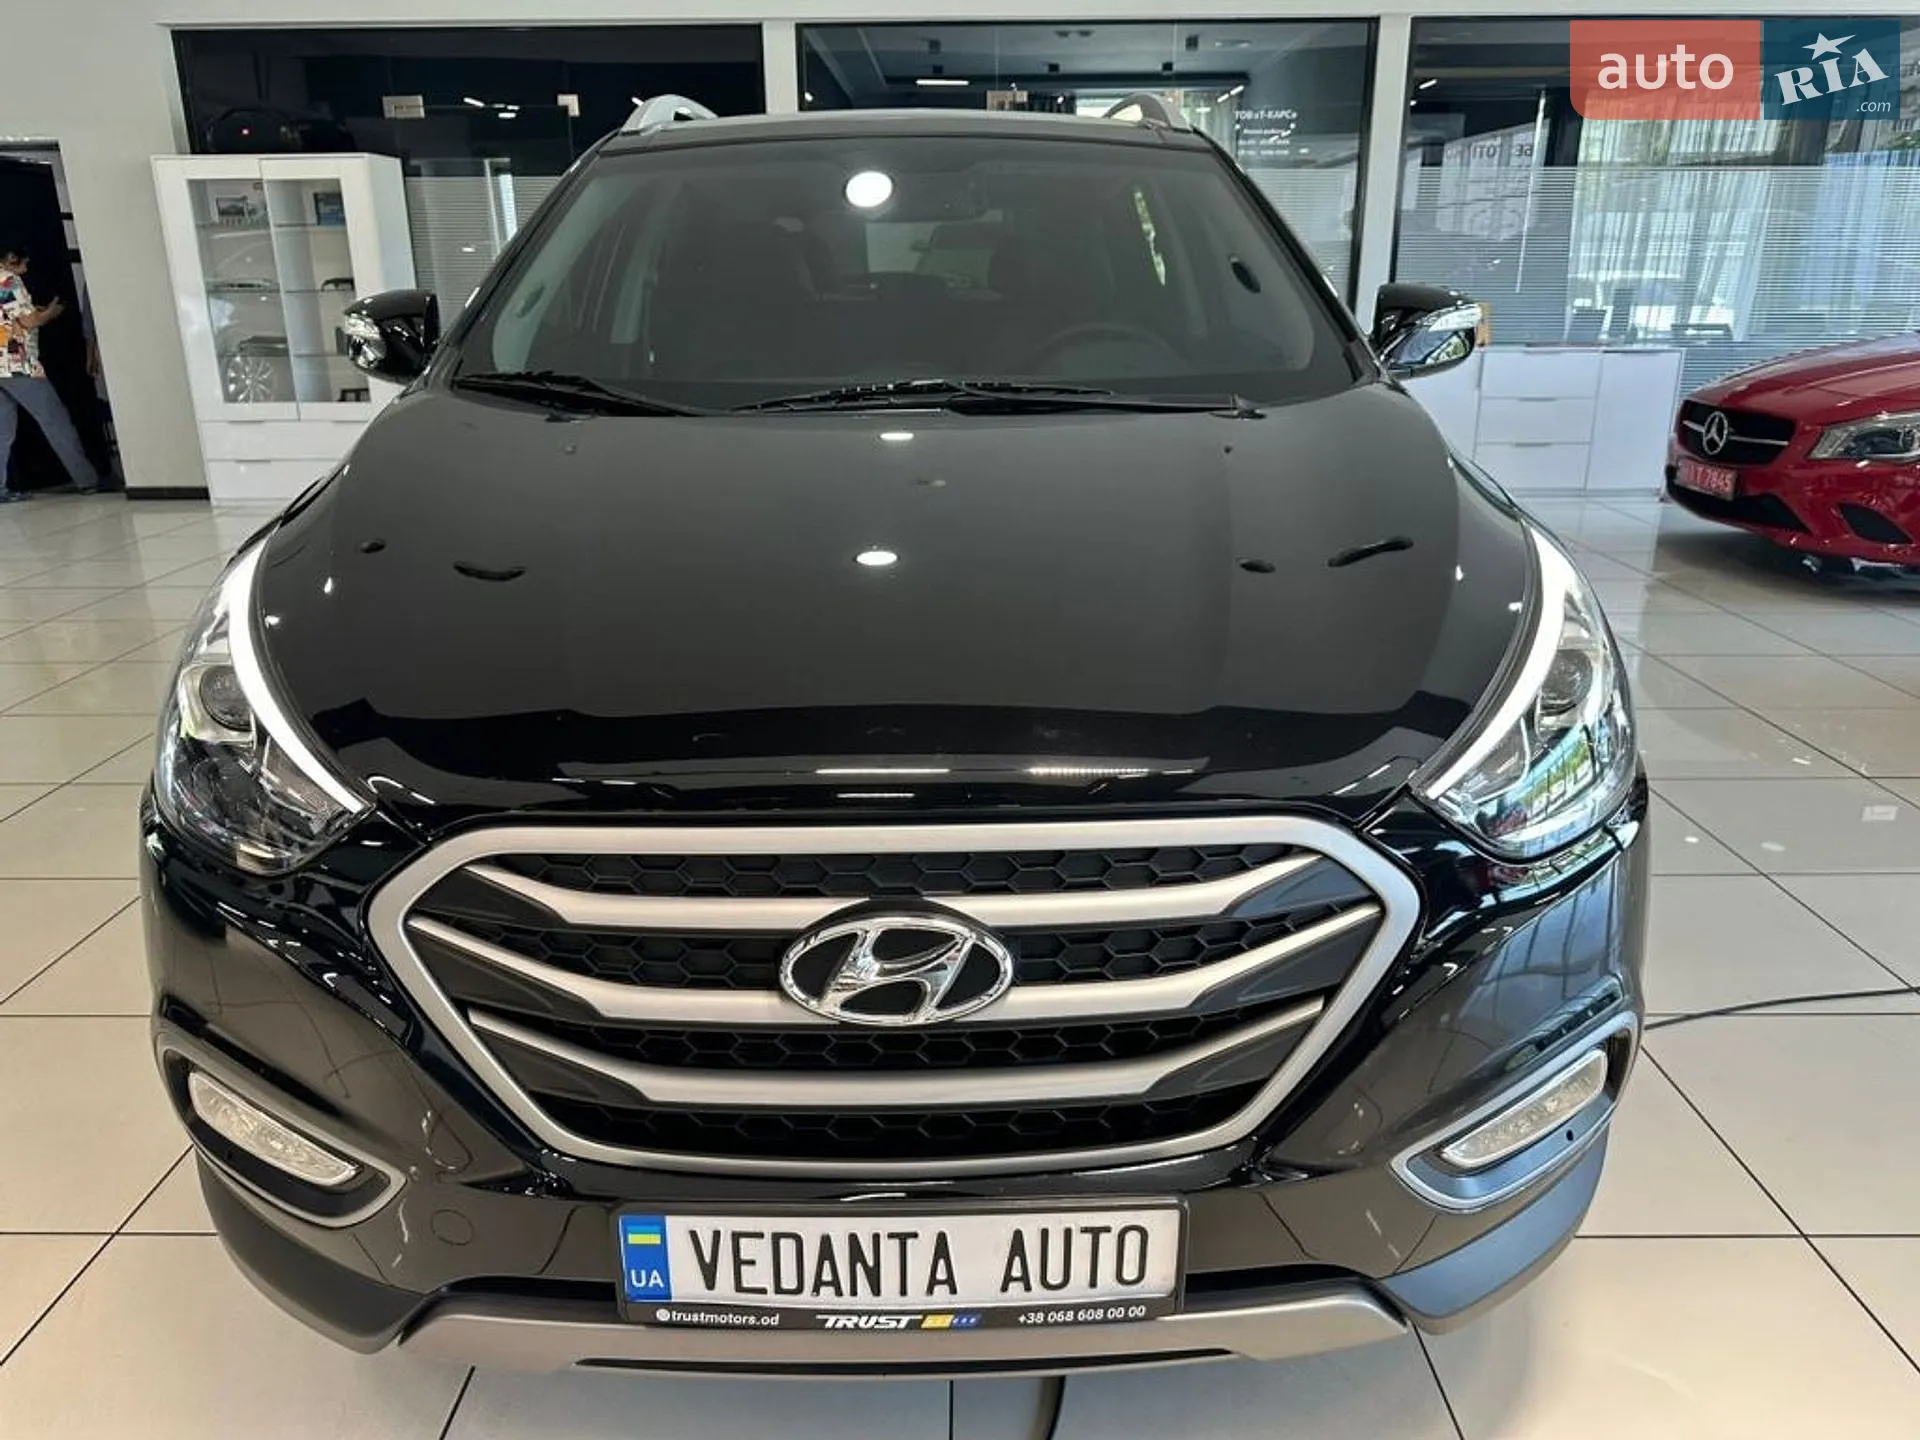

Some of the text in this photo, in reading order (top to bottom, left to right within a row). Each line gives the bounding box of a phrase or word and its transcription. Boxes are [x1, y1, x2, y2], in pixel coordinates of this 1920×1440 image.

[688, 1224, 1149, 1297] VEDANTA AUTO
[630, 1269, 664, 1288] UA
[671, 1310, 780, 1326] trustmotors.od
[815, 1314, 923, 1329] TRUST
[1018, 1304, 1146, 1324] +38 068 608 00 00
